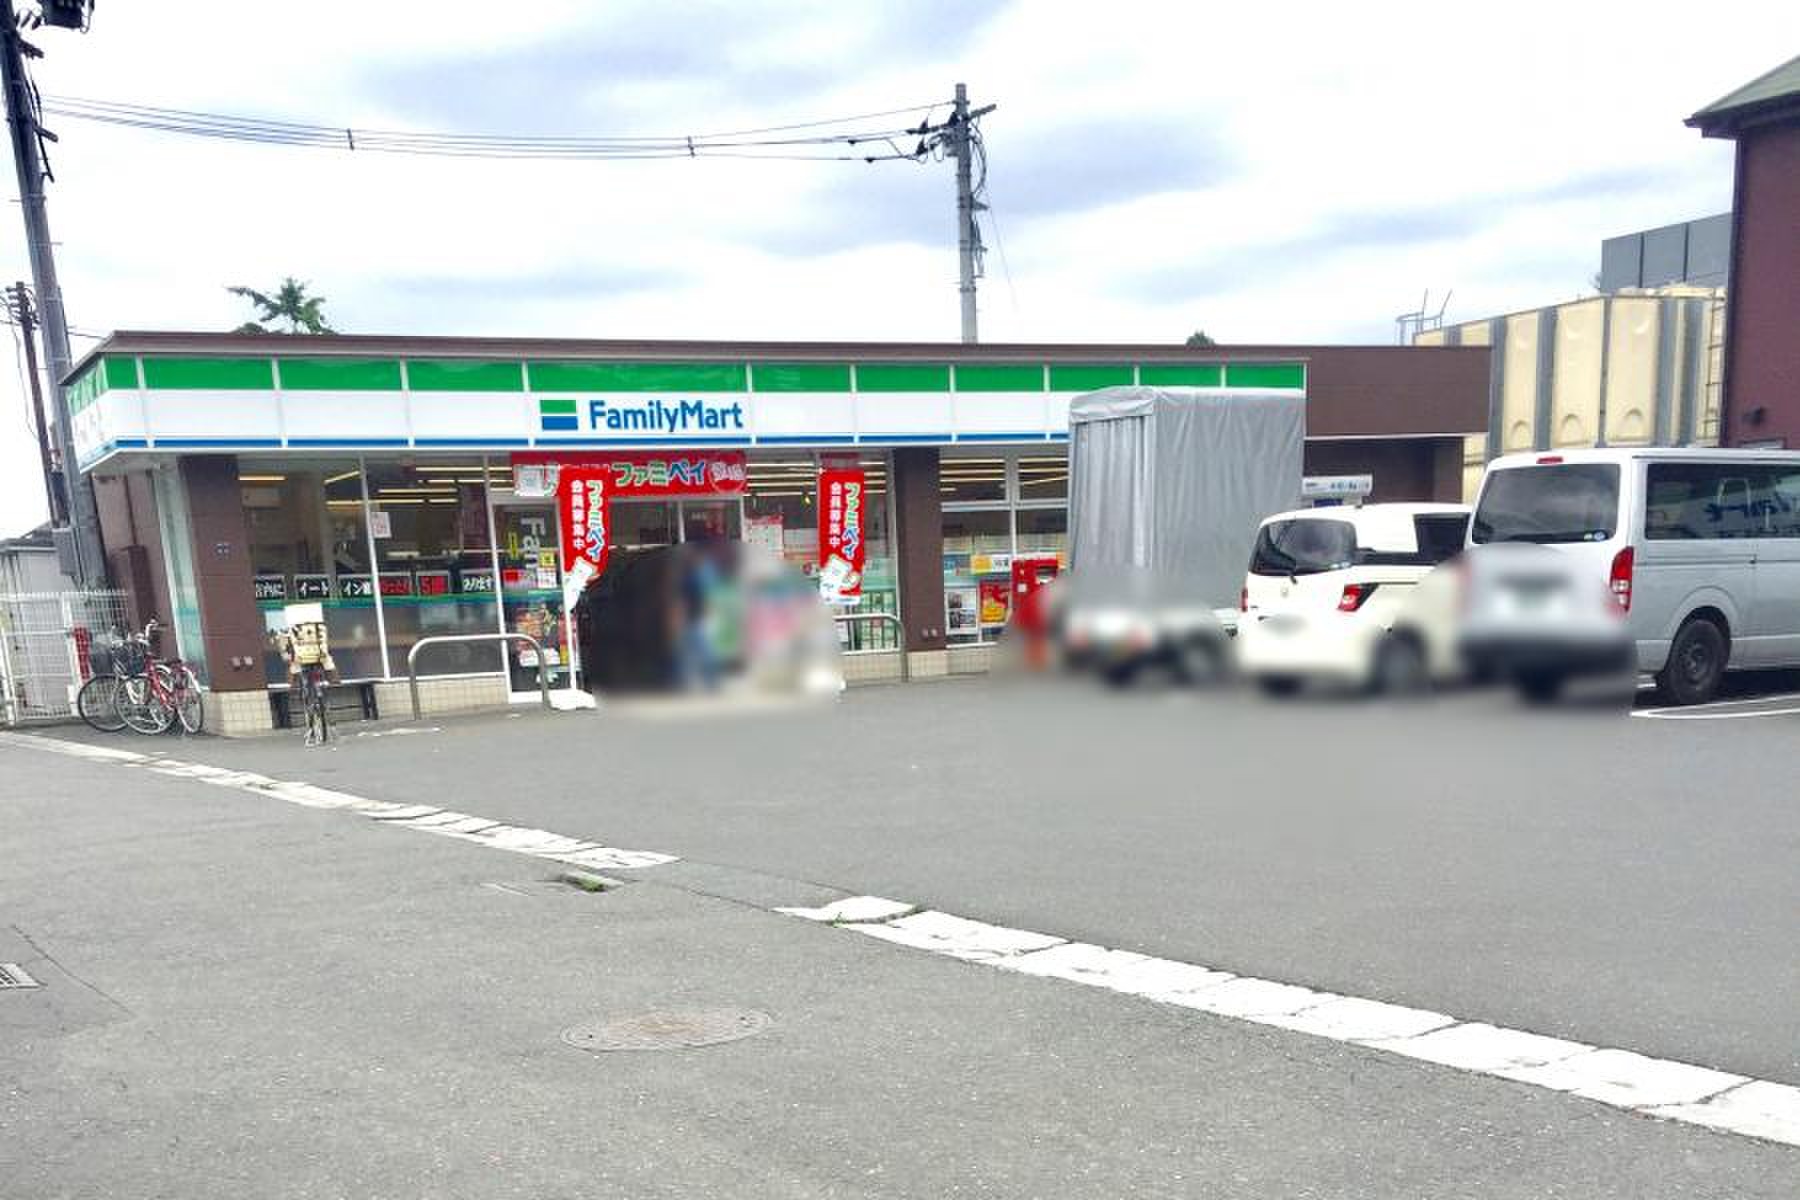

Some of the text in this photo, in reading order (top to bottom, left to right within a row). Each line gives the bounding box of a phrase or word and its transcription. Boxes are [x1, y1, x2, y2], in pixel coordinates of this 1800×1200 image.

[589, 399, 744, 433] FamilyMart
[611, 460, 706, 488] ファミペイ
